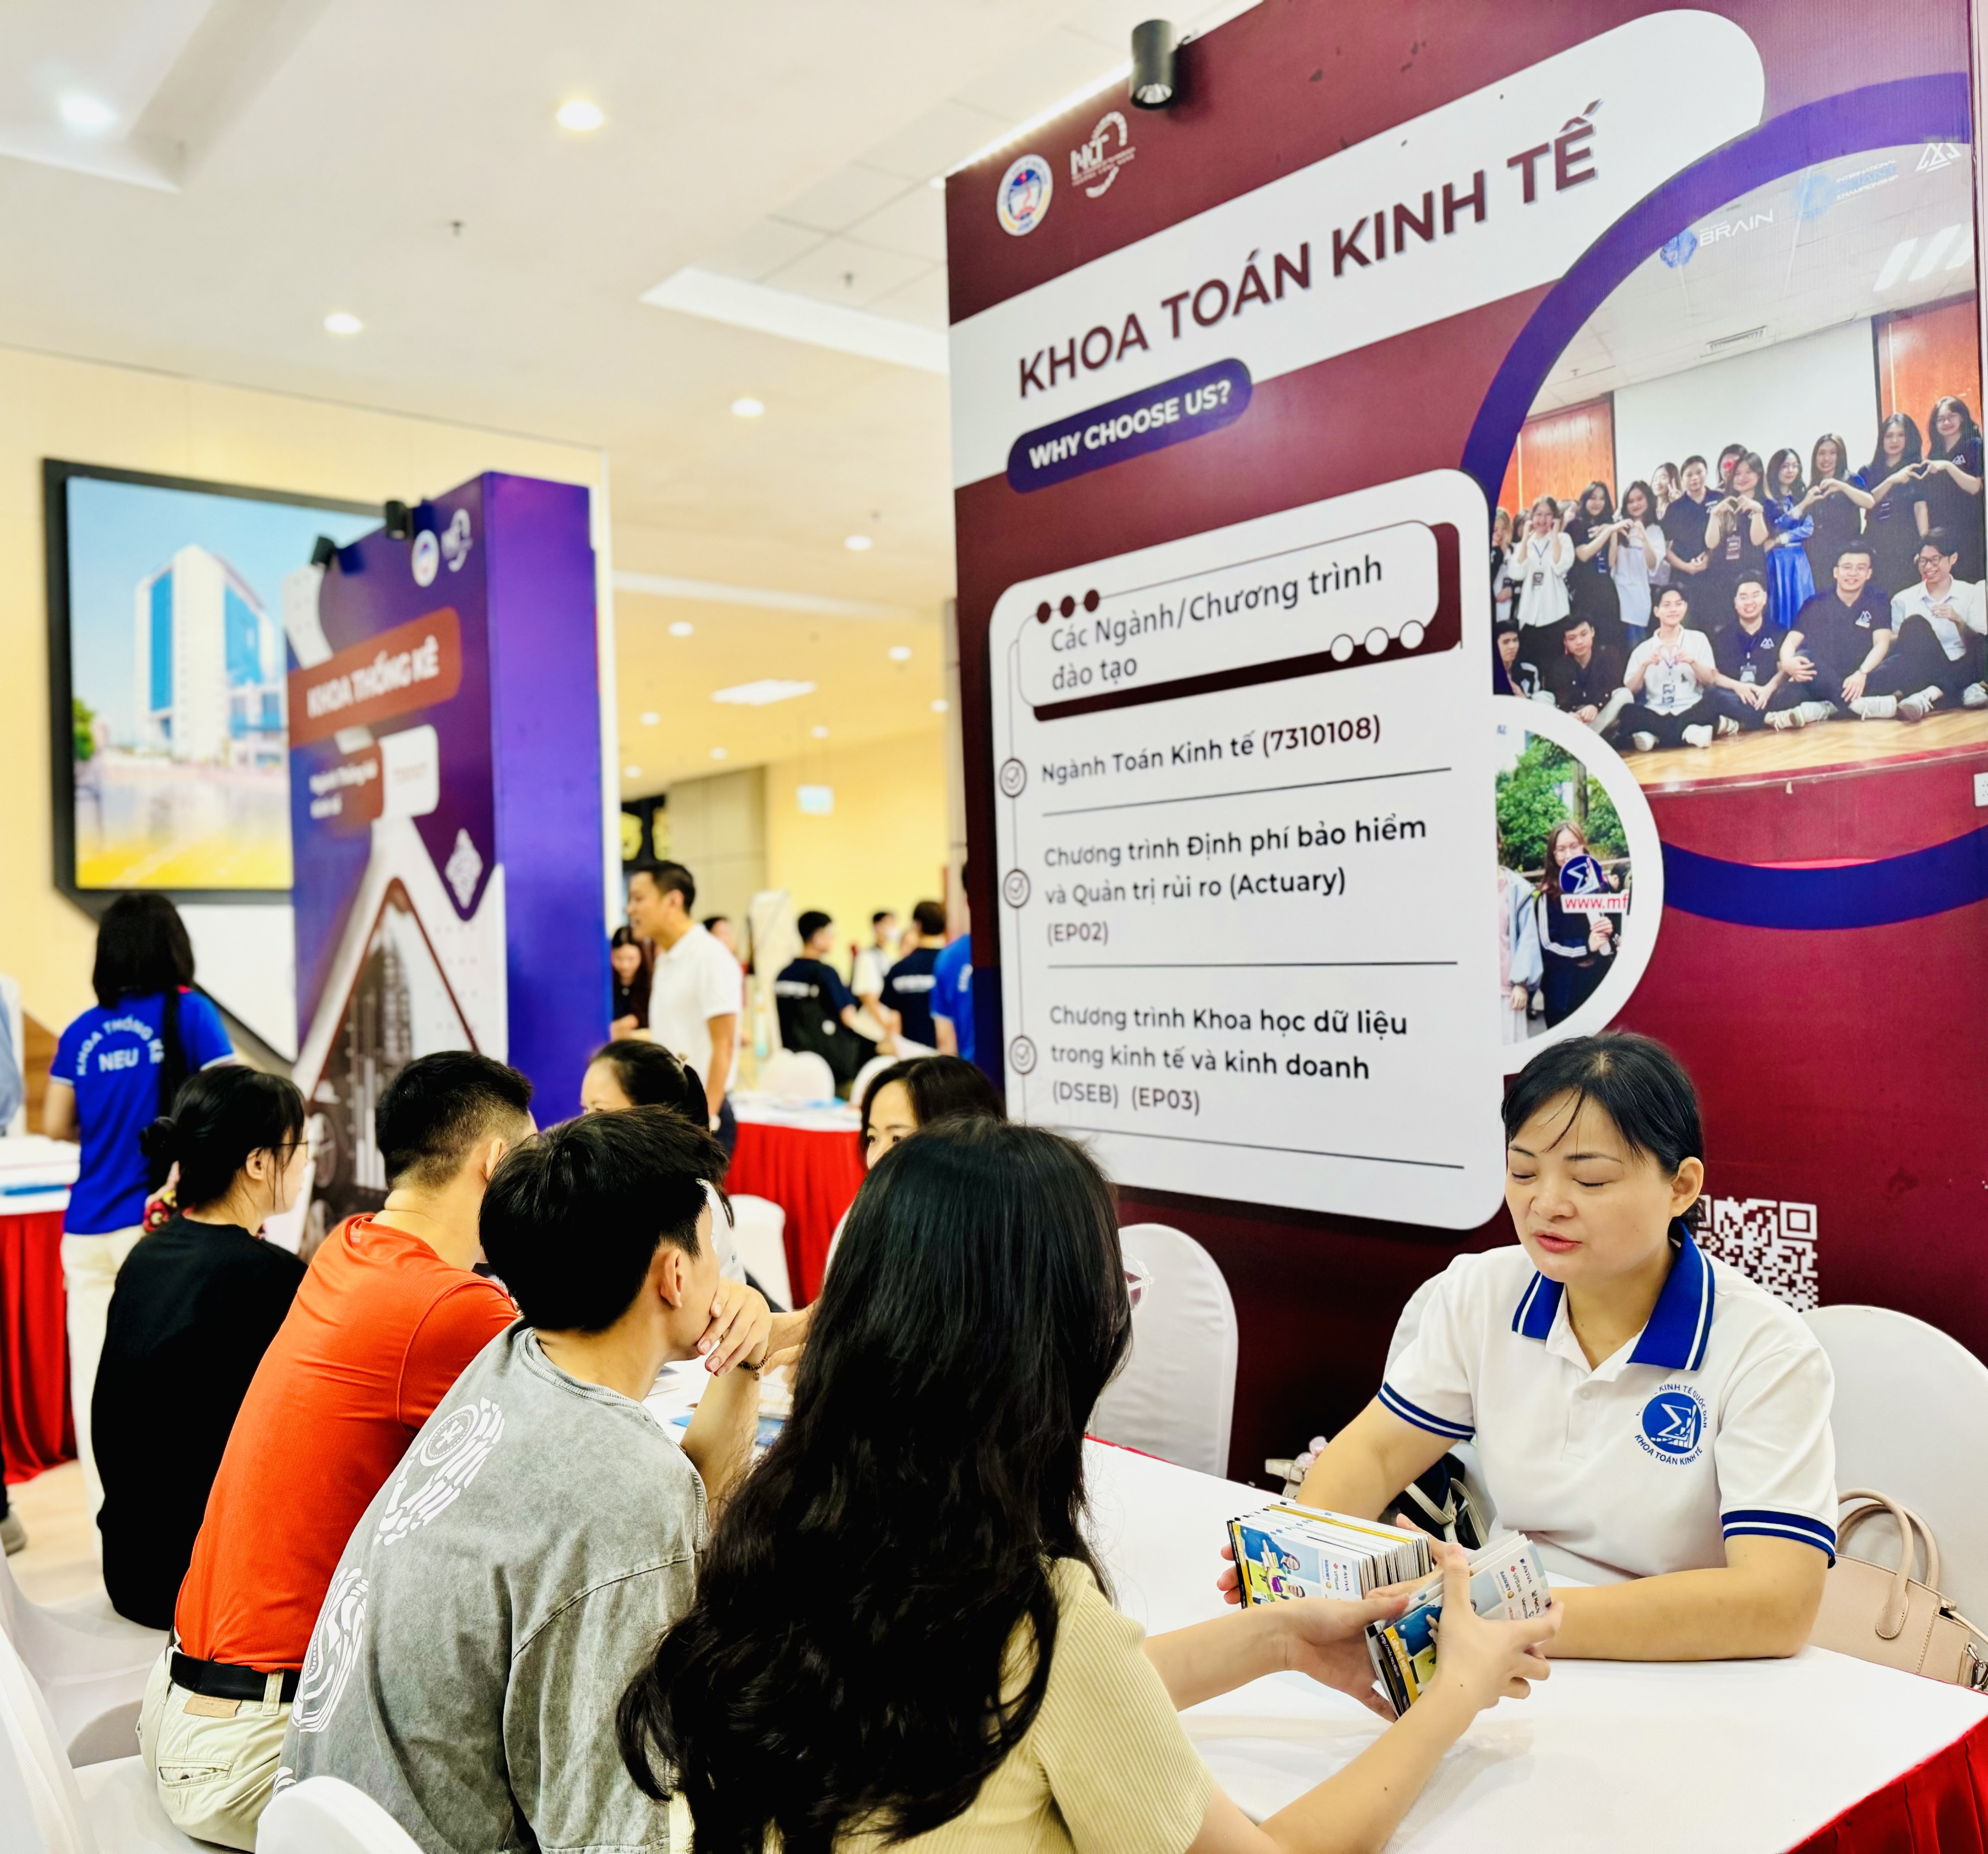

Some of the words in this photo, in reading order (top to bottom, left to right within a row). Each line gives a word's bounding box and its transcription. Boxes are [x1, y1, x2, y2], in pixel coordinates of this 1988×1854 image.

[1837, 158, 1897, 183] INTERNATIONAL
[1837, 174, 1898, 200] CHAMPIONSHIP
[1699, 208, 1773, 247] BRAIN
[1019, 313, 1150, 398] KHOA
[1162, 243, 1311, 340] TOÁN
[1333, 170, 1486, 278] KINH
[1507, 98, 1602, 204] TẾ
[1029, 431, 1081, 469] WHY
[1084, 398, 1180, 450] CHOOSE
[1184, 380, 1232, 415] US?
[1051, 624, 1088, 653] Các
[1308, 554, 1383, 596] trình
[1052, 663, 1093, 691] đào
[1100, 657, 1138, 686] tạo
[1042, 755, 1107, 785] Ngành
[1112, 747, 1164, 774] Toán
[1171, 740, 1222, 766] Kinh
[1230, 729, 1256, 756] tế
[1262, 714, 1381, 759] (7310108)
[1045, 845, 1121, 867] Chương
[1128, 837, 1179, 860] trình
[1187, 832, 1242, 860] Định
[1251, 826, 1290, 856] phí
[1298, 821, 1346, 847] bảo
[1355, 813, 1426, 843] hiểm
[1045, 884, 1066, 904] và
[1133, 878, 1155, 904] trị
[1163, 875, 1191, 898] rủi
[1199, 880, 1222, 897] ro
[1230, 866, 1345, 900] (Actuary)
[1047, 921, 1108, 947] (EP02)
[1050, 1004, 1127, 1031] Chương
[1133, 1007, 1185, 1028] trình
[1193, 1008, 1251, 1031] Khoa
[1261, 1009, 1306, 1037] học
[1313, 1010, 1348, 1033] dữ
[1358, 1009, 1407, 1040] liệu
[76, 1031, 103, 1076] KHOA
[102, 1013, 154, 1040] THỐNG
[98, 1047, 139, 1072] NEU
[1051, 1045, 1103, 1069] trong
[1111, 1044, 1156, 1068] kinh
[1162, 1046, 1186, 1069] tế
[1191, 1049, 1216, 1071] và
[1225, 1050, 1277, 1074] kinh
[1285, 1053, 1369, 1080] doanh
[1053, 1080, 1119, 1109] (DSEB)
[1132, 1085, 1200, 1117] (EP03)
[1659, 1384, 1680, 1392] KINH
[1683, 1385, 1693, 1394] TẾ
[1634, 1434, 1655, 1456] KHOA
[1655, 1452, 1678, 1465] TOÁN
[1680, 1453, 1696, 1465] KINH
[1522, 1565, 1532, 1584] AVIVA
